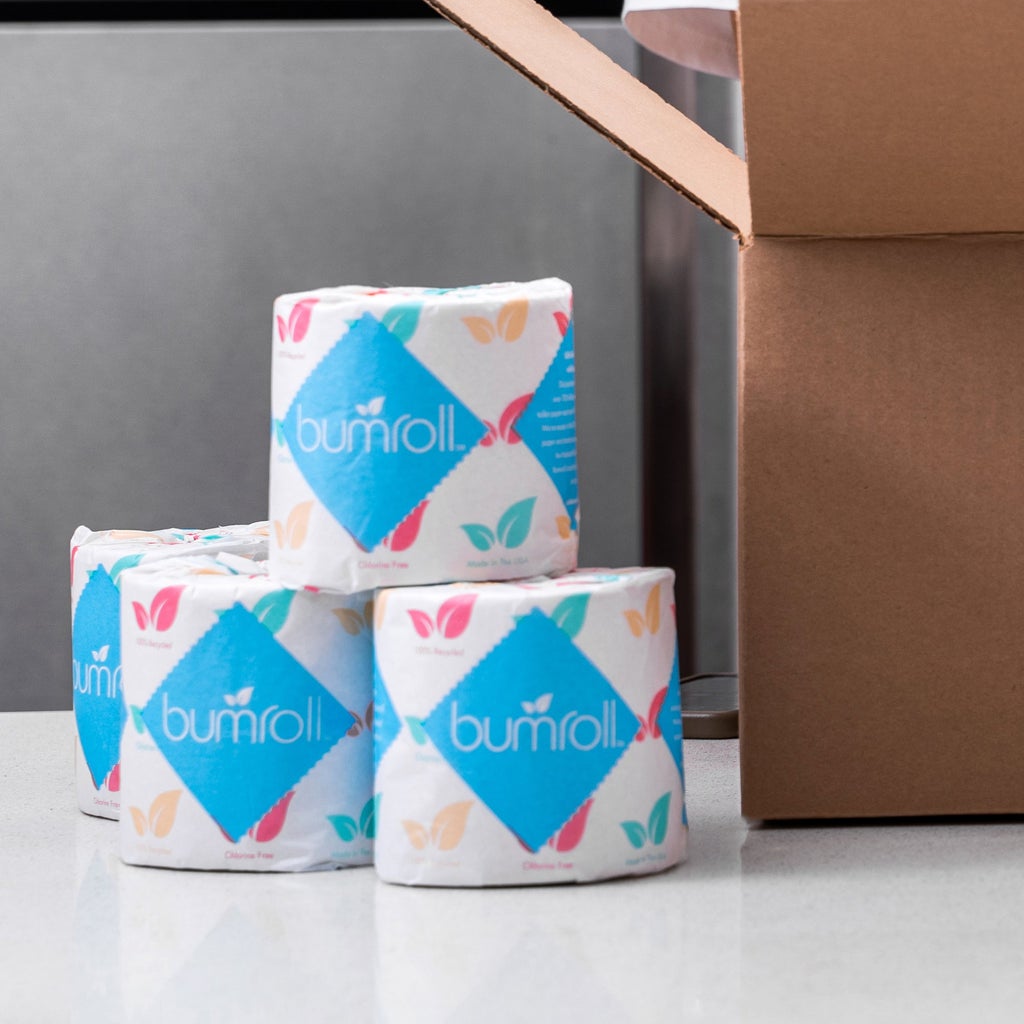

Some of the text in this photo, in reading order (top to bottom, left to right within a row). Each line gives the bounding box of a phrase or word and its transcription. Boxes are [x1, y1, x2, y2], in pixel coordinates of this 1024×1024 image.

[296, 404, 455, 453] bumroll
[162, 692, 322, 744] bumroll
[451, 700, 617, 752] bumroll
